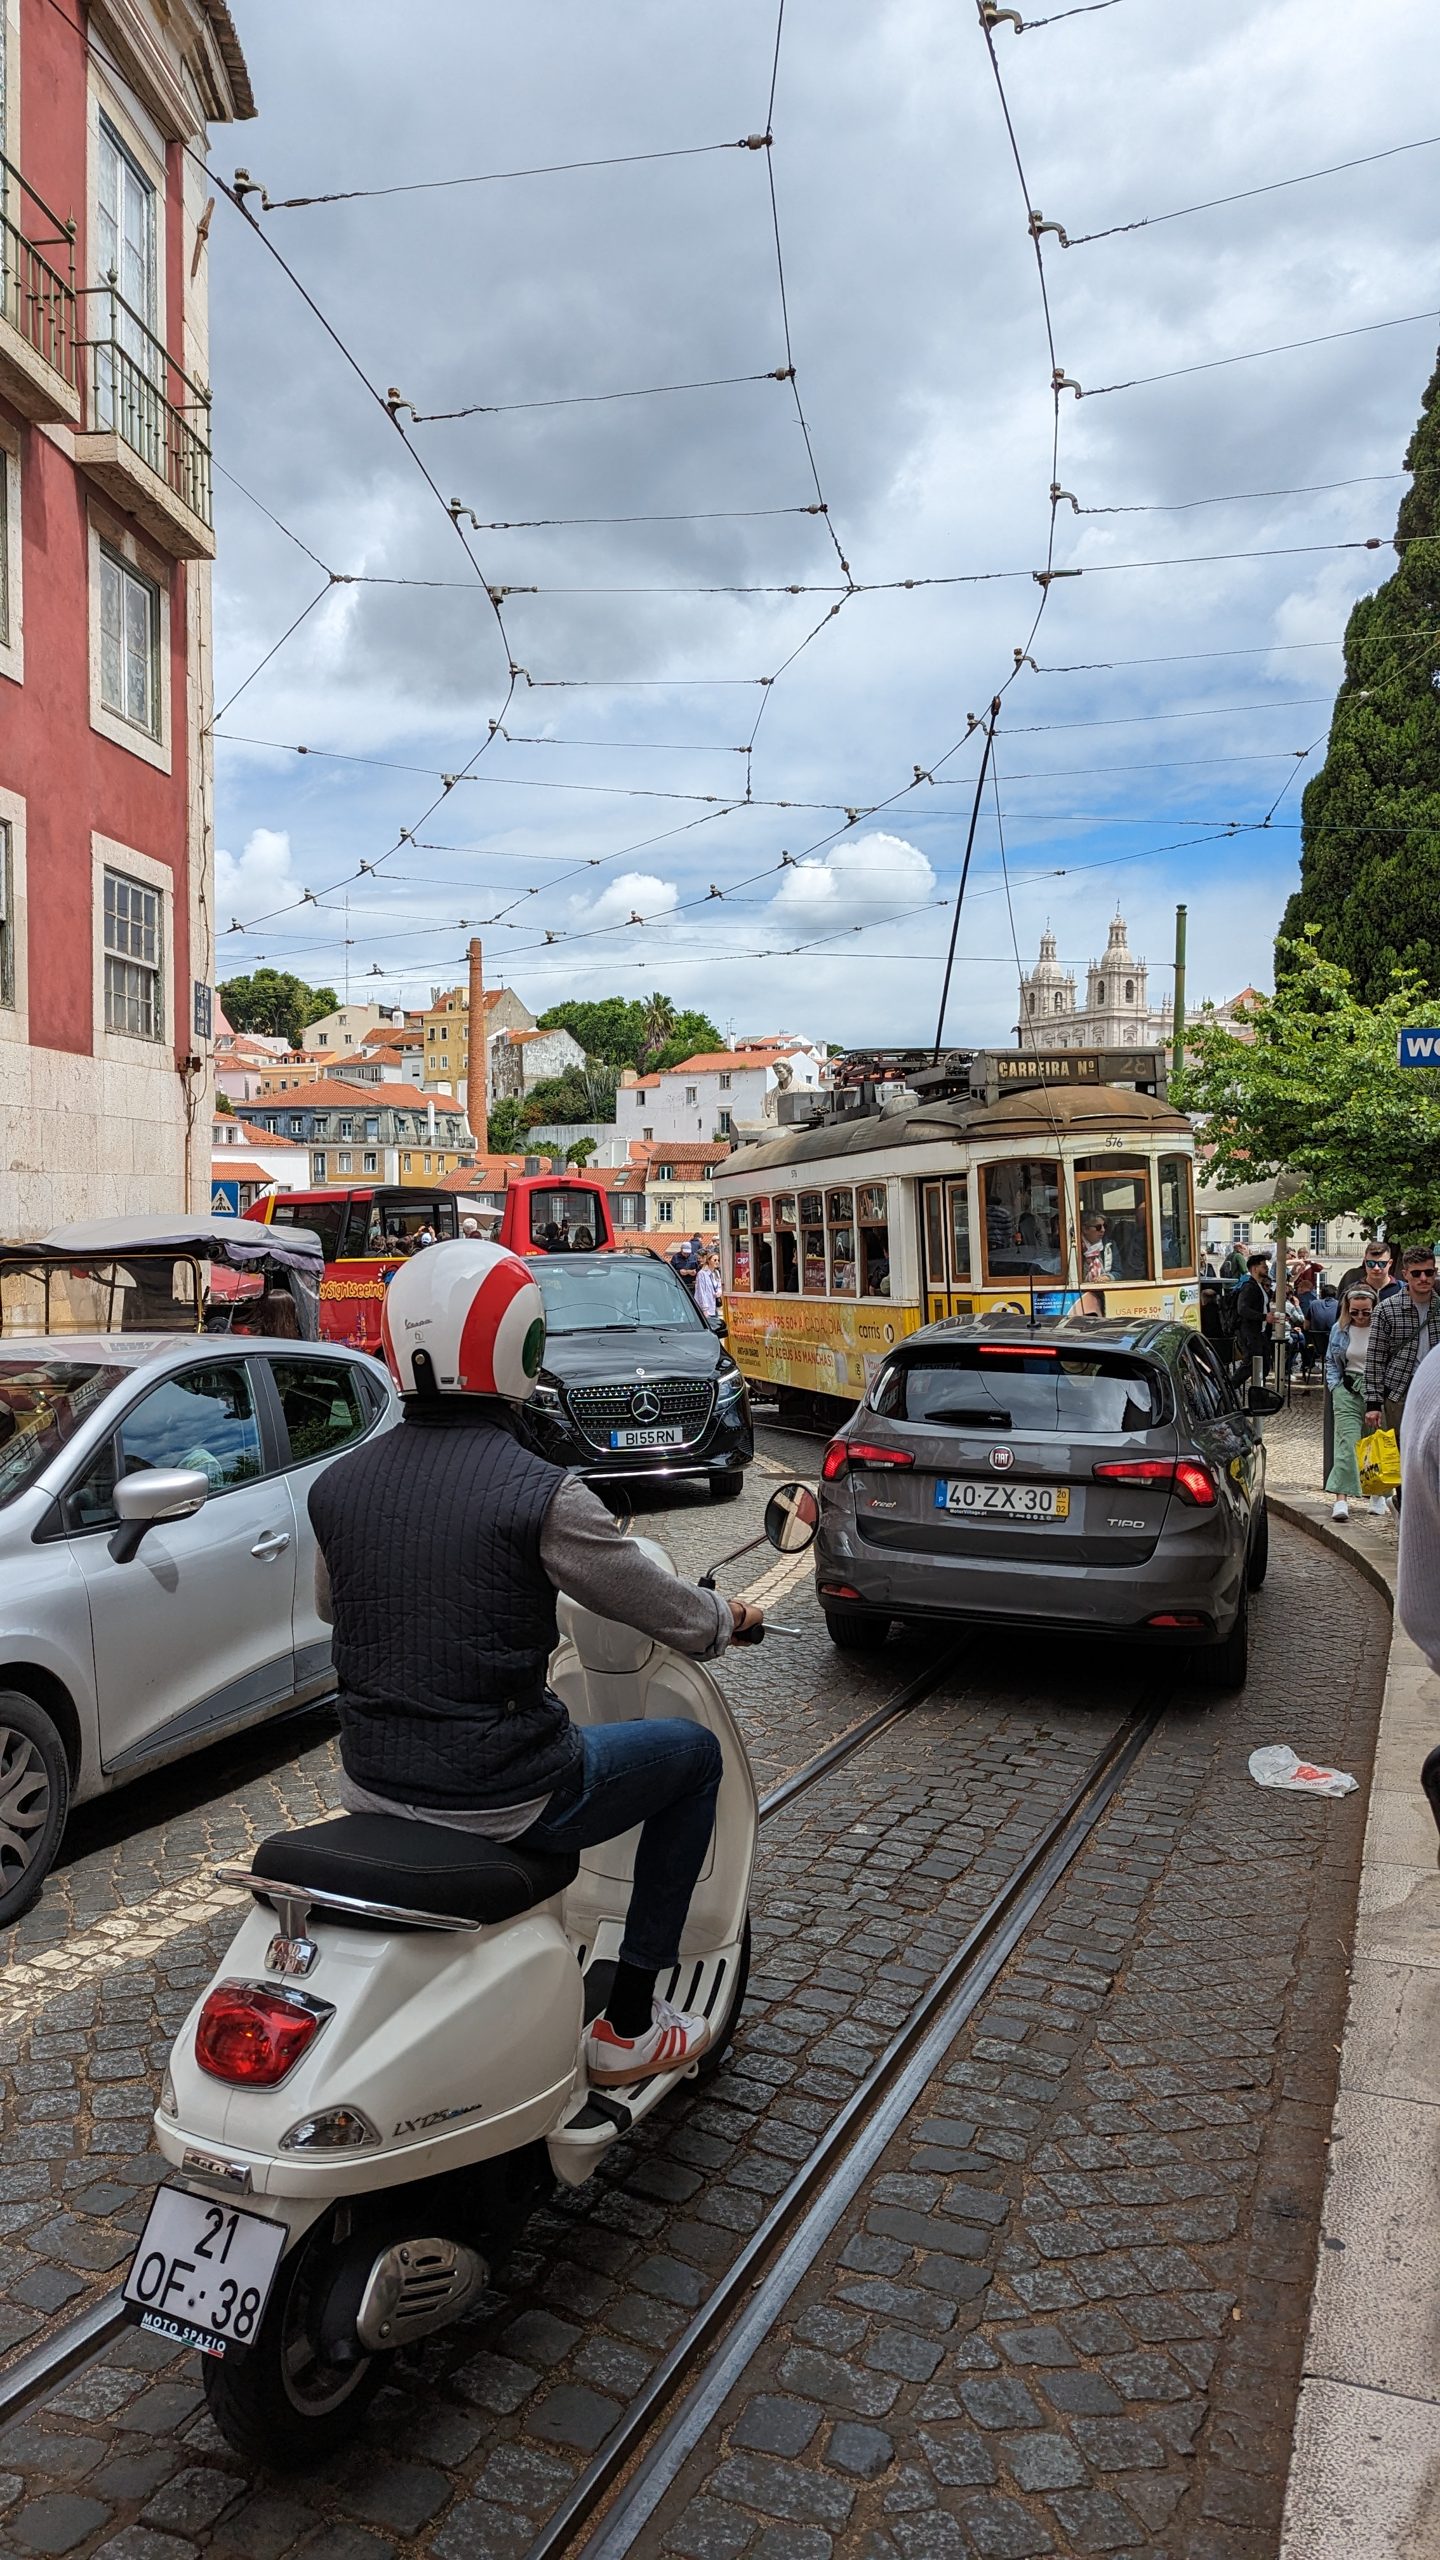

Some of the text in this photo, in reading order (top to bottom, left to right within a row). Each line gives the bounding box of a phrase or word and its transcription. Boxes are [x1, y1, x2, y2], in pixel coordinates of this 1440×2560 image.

[999, 1060, 1095, 1078] CARREIRA Nº
[1119, 1056, 1147, 1075] 28
[1105, 1137, 1123, 1148] 576
[1115, 1306, 1161, 1316] USA FPS 50+
[404, 1318, 432, 1330] Vespa
[859, 1321, 881, 1340] carris
[994, 1453, 1009, 1465] FIAT
[1056, 1505, 1066, 1514] 02
[1106, 1518, 1145, 1529] TIPO
[193, 2207, 240, 2264] 21
[142, 2312, 179, 2334] MOTO
[182, 2326, 227, 2351] SPAZIO
